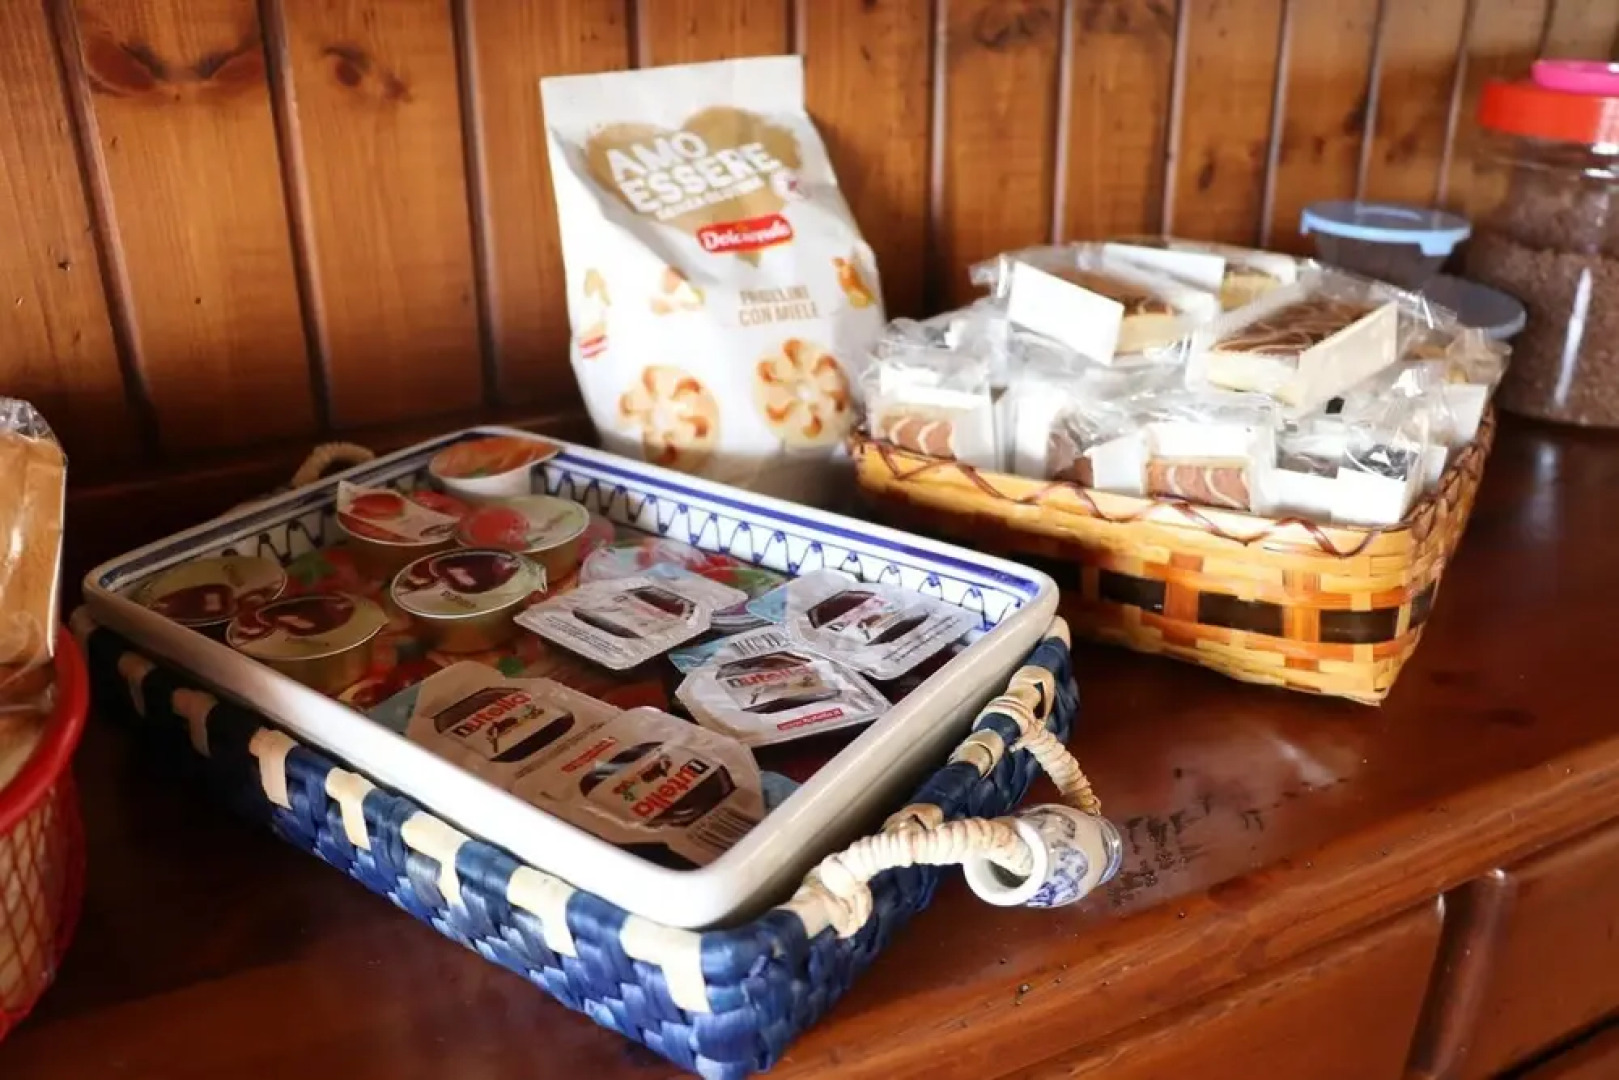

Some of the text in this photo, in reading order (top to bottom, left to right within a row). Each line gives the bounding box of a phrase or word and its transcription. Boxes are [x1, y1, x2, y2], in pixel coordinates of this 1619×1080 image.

[607, 132, 707, 184] AMO
[620, 142, 782, 214] ESSERE
[738, 306, 773, 327] CON
[451, 690, 532, 738] nutella
[631, 757, 711, 818] nutella
